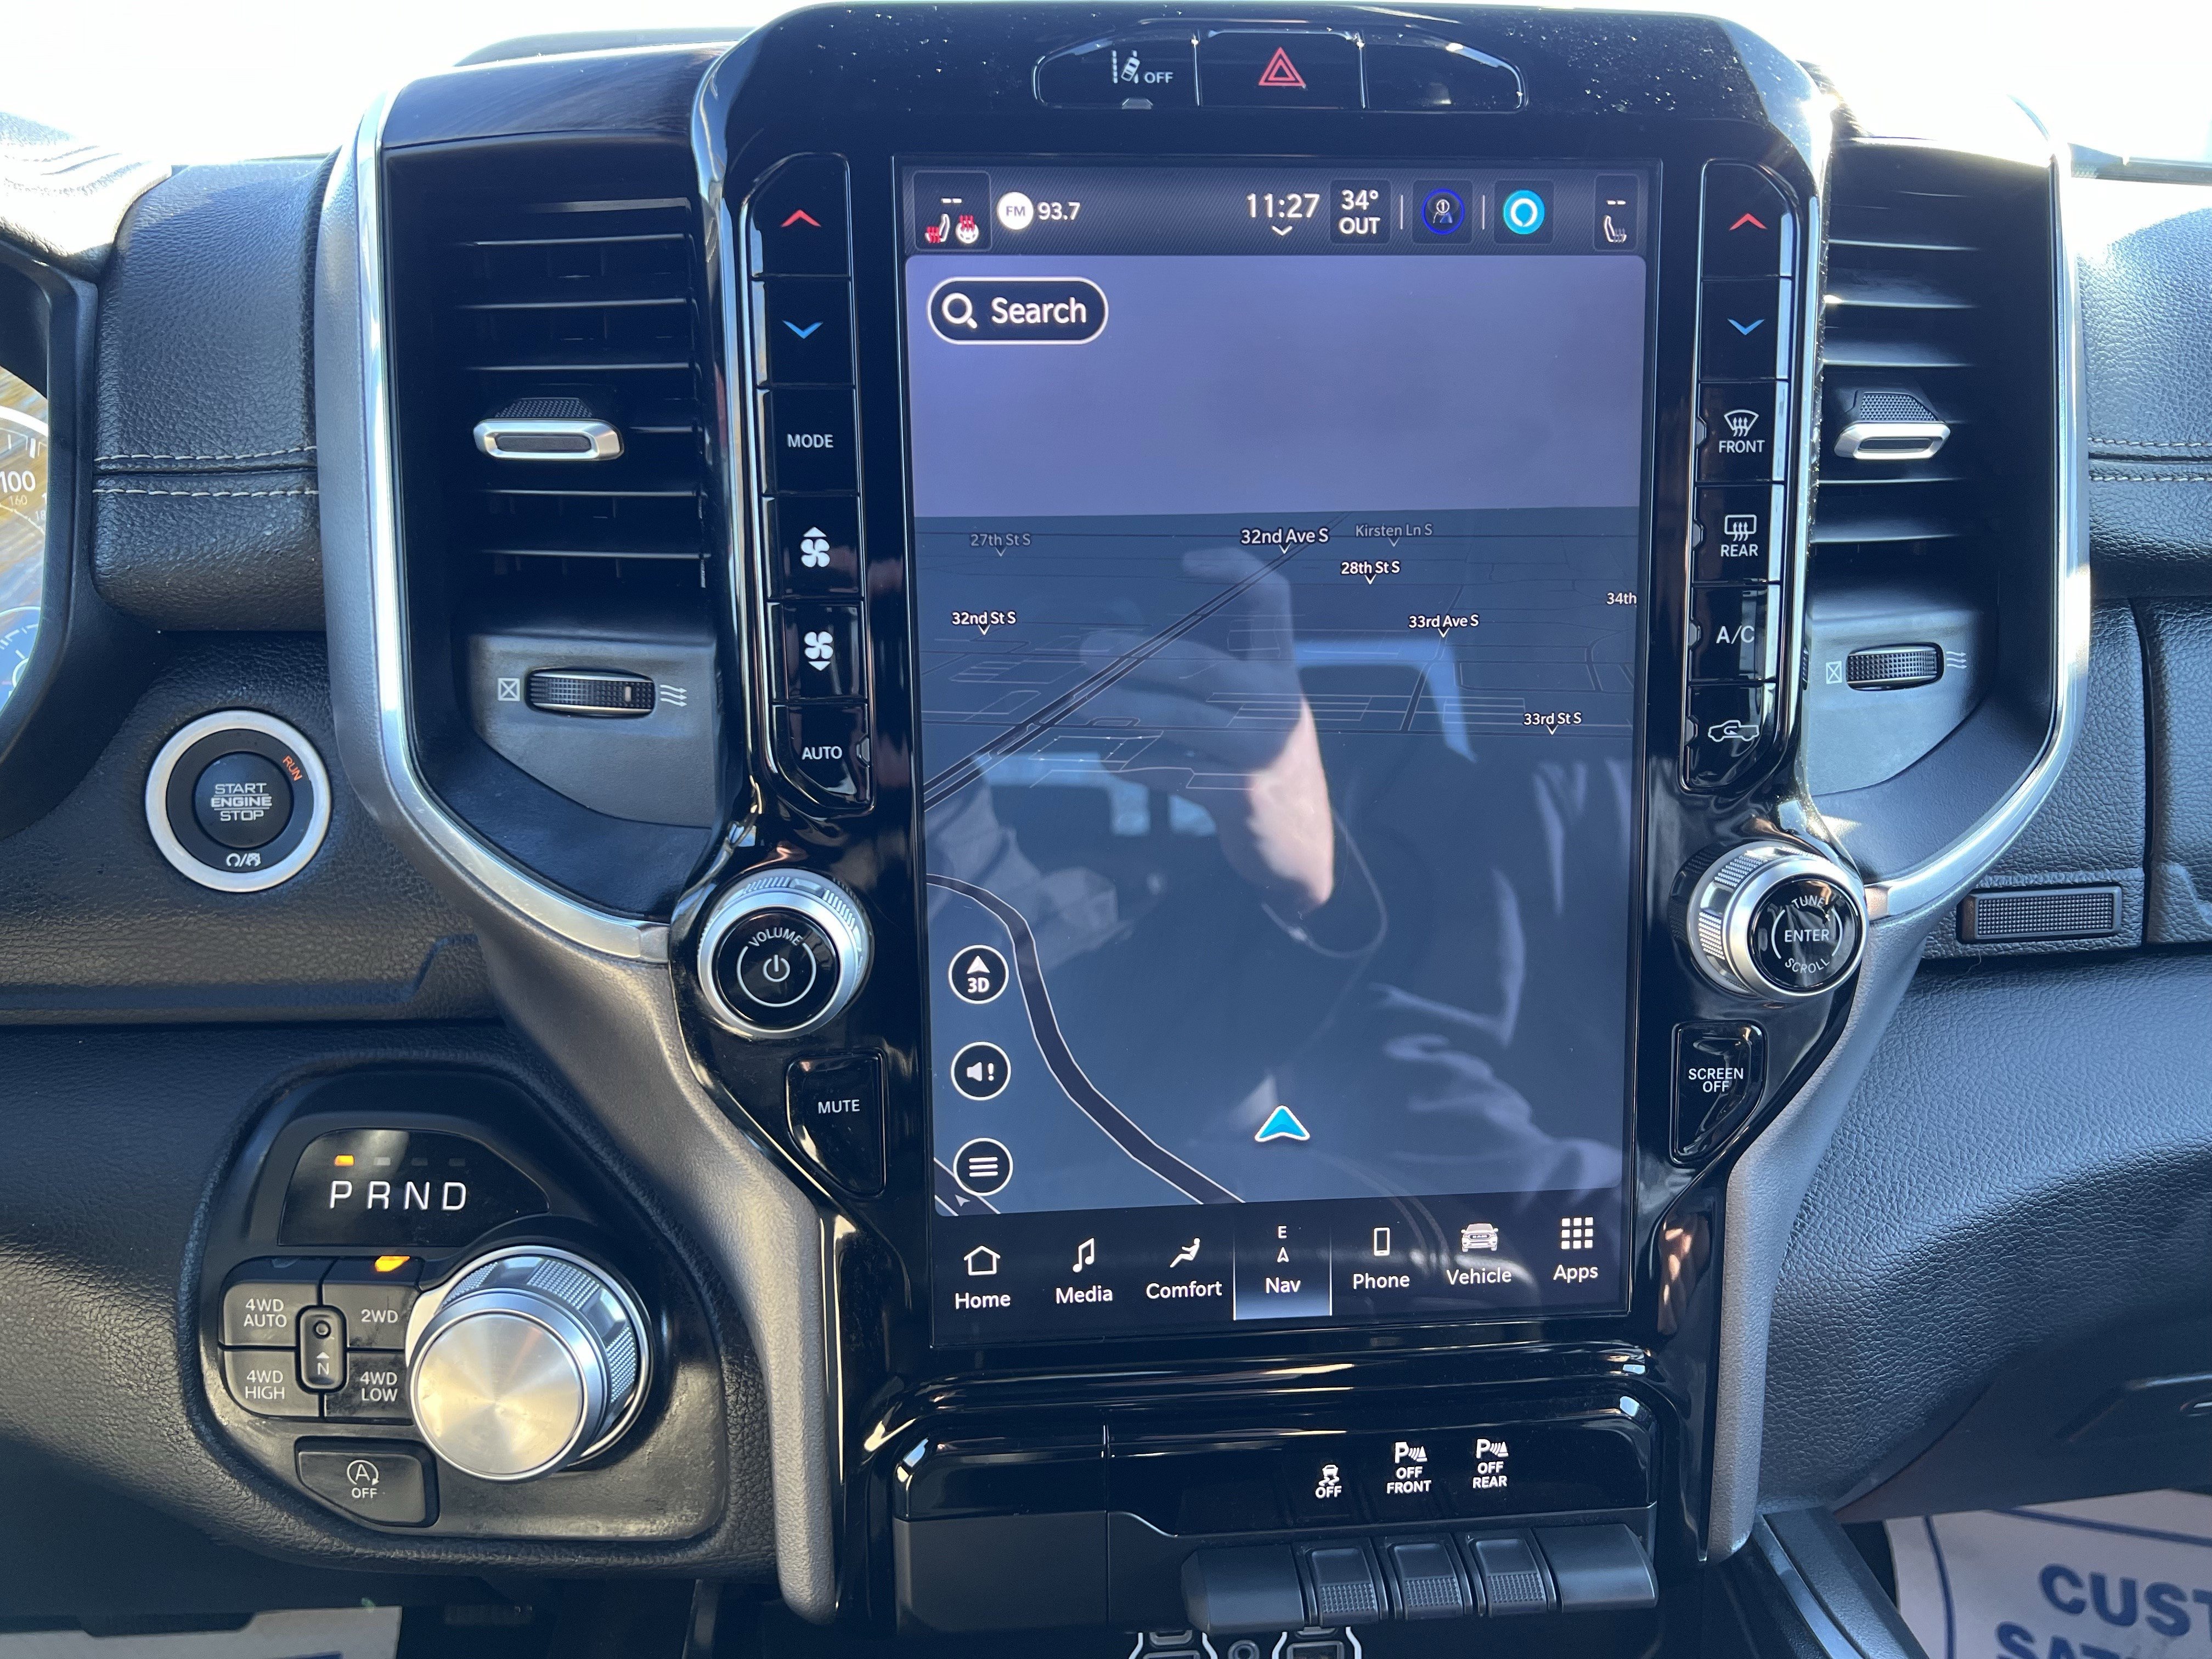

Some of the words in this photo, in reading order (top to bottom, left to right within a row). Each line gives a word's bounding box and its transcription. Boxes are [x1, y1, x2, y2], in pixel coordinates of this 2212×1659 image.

[1144, 71, 1173, 83] OFF
[1247, 193, 1320, 218] 11:27
[1341, 189, 1379, 210] 34°
[1006, 206, 1025, 217] FM
[1037, 201, 1081, 220] 93.7
[1339, 217, 1381, 234] OUT
[991, 297, 1086, 324] Search
[787, 433, 834, 448] MODE
[1719, 439, 1765, 453] FRONT
[0, 471, 36, 493] 100
[1241, 529, 1282, 544] 32nd
[1285, 529, 1314, 543] Ave
[1319, 528, 1329, 543] S
[1356, 524, 1402, 537] Kirsten
[1406, 524, 1421, 536] Ln
[1424, 523, 1432, 536] S
[970, 534, 1002, 546] 27th
[1006, 533, 1020, 546] St
[1022, 533, 1031, 546] S
[1720, 544, 1758, 557] REAR
[1341, 561, 1372, 575] 28th
[1375, 561, 1389, 574] St
[1391, 561, 1400, 573] S
[1606, 592, 1637, 605] 34th
[952, 612, 987, 625] 32nd
[990, 612, 1005, 625] St
[1007, 611, 1016, 624] S
[1408, 614, 1440, 628] 33rd
[1443, 614, 1468, 627] Ave
[1470, 614, 1479, 627] S
[1716, 625, 1754, 644] A/C
[1523, 713, 1554, 725] 33rd
[1558, 713, 1571, 724] St
[1573, 713, 1582, 724] S
[802, 746, 843, 760] AUTO
[283, 755, 302, 781] RUN
[215, 783, 267, 794] START
[211, 796, 272, 808] ENGINE
[220, 810, 264, 821] STOP
[1792, 895, 1825, 910] TUNE
[749, 927, 804, 948] VOLUME
[1784, 929, 1830, 942] ENTER
[1784, 958, 1830, 974] SCROLL
[968, 977, 990, 993] 3D
[1688, 1068, 1744, 1080] SCREEN
[1702, 1081, 1730, 1093] OFF
[818, 1099, 860, 1114] MUTE
[1278, 1226, 1287, 1239] E
[1446, 1266, 1512, 1285] Vehicle
[1553, 1264, 1598, 1283] Apps
[1266, 1277, 1301, 1294] Nav
[1353, 1272, 1410, 1290] Phone
[1056, 1285, 1113, 1304] Media
[1146, 1280, 1222, 1299] Comfort
[245, 1299, 284, 1312] 4WD
[955, 1292, 1011, 1310] Home
[244, 1313, 287, 1328] AUTO
[361, 1309, 398, 1324] 2WD
[317, 1362, 329, 1375] N
[246, 1370, 283, 1384] 4WD
[360, 1372, 397, 1386] 4WD
[245, 1385, 285, 1400] HIGH
[362, 1387, 398, 1402] LOW
[355, 1464, 371, 1481] A
[1396, 1466, 1423, 1480] OFF
[1477, 1461, 1504, 1475] OFF
[1386, 1480, 1431, 1494] FRONT
[1472, 1475, 1507, 1488] REAR
[352, 1488, 377, 1498] OFF
[1316, 1486, 1342, 1499] OFF
